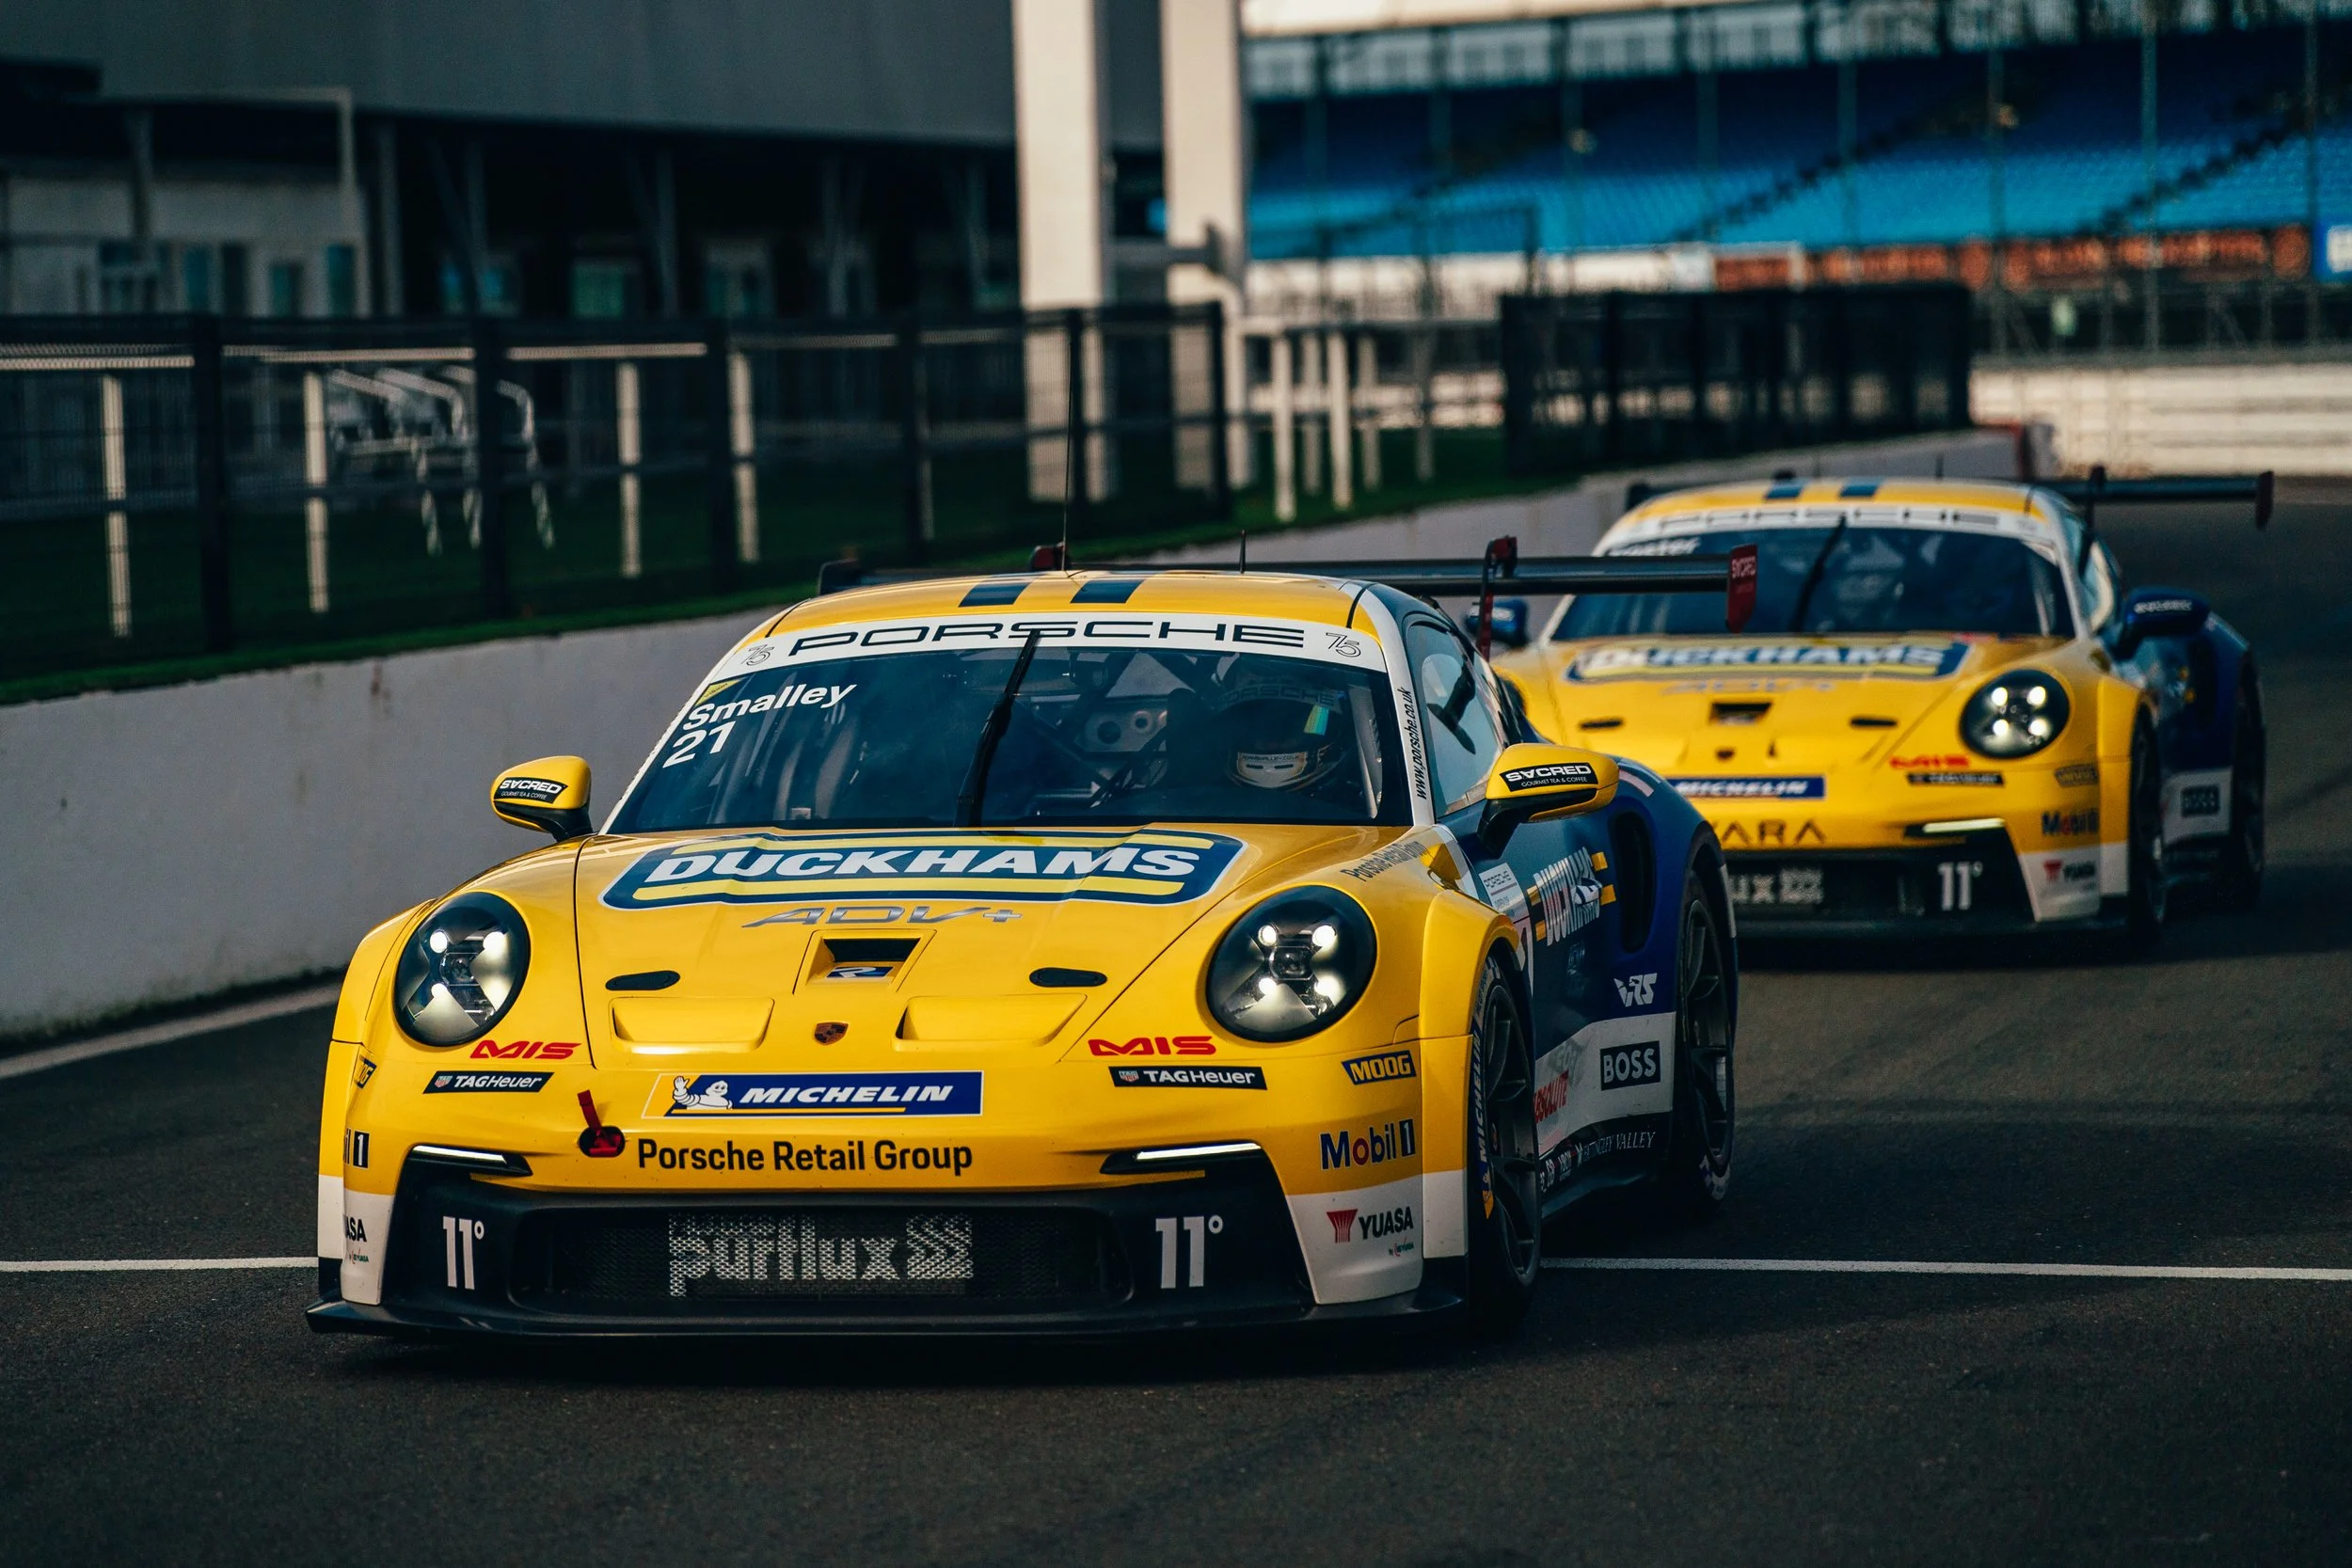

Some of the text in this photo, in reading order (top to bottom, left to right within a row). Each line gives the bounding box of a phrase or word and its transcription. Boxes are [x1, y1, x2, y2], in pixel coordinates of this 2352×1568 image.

[788, 621, 1304, 657] PORSCHE
[1326, 632, 1360, 657] 75
[683, 684, 857, 731] Smalley
[662, 721, 737, 768] 21
[1521, 779, 1549, 787] GOURMET
[1714, 819, 1827, 846] ARA
[644, 847, 1200, 884] DUCKHAMS
[741, 906, 1023, 928] ADV+
[470, 1040, 581, 1059] MIS
[1088, 1036, 1216, 1056] MIS
[1351, 1054, 1411, 1083] MOOG
[1603, 1048, 1656, 1085] BOSS
[739, 1085, 954, 1103] MICHELIN
[638, 1137, 973, 1176] Porsche Retail Group
[1320, 1123, 1397, 1170] Mobil
[1359, 1206, 1414, 1240] YUASA
